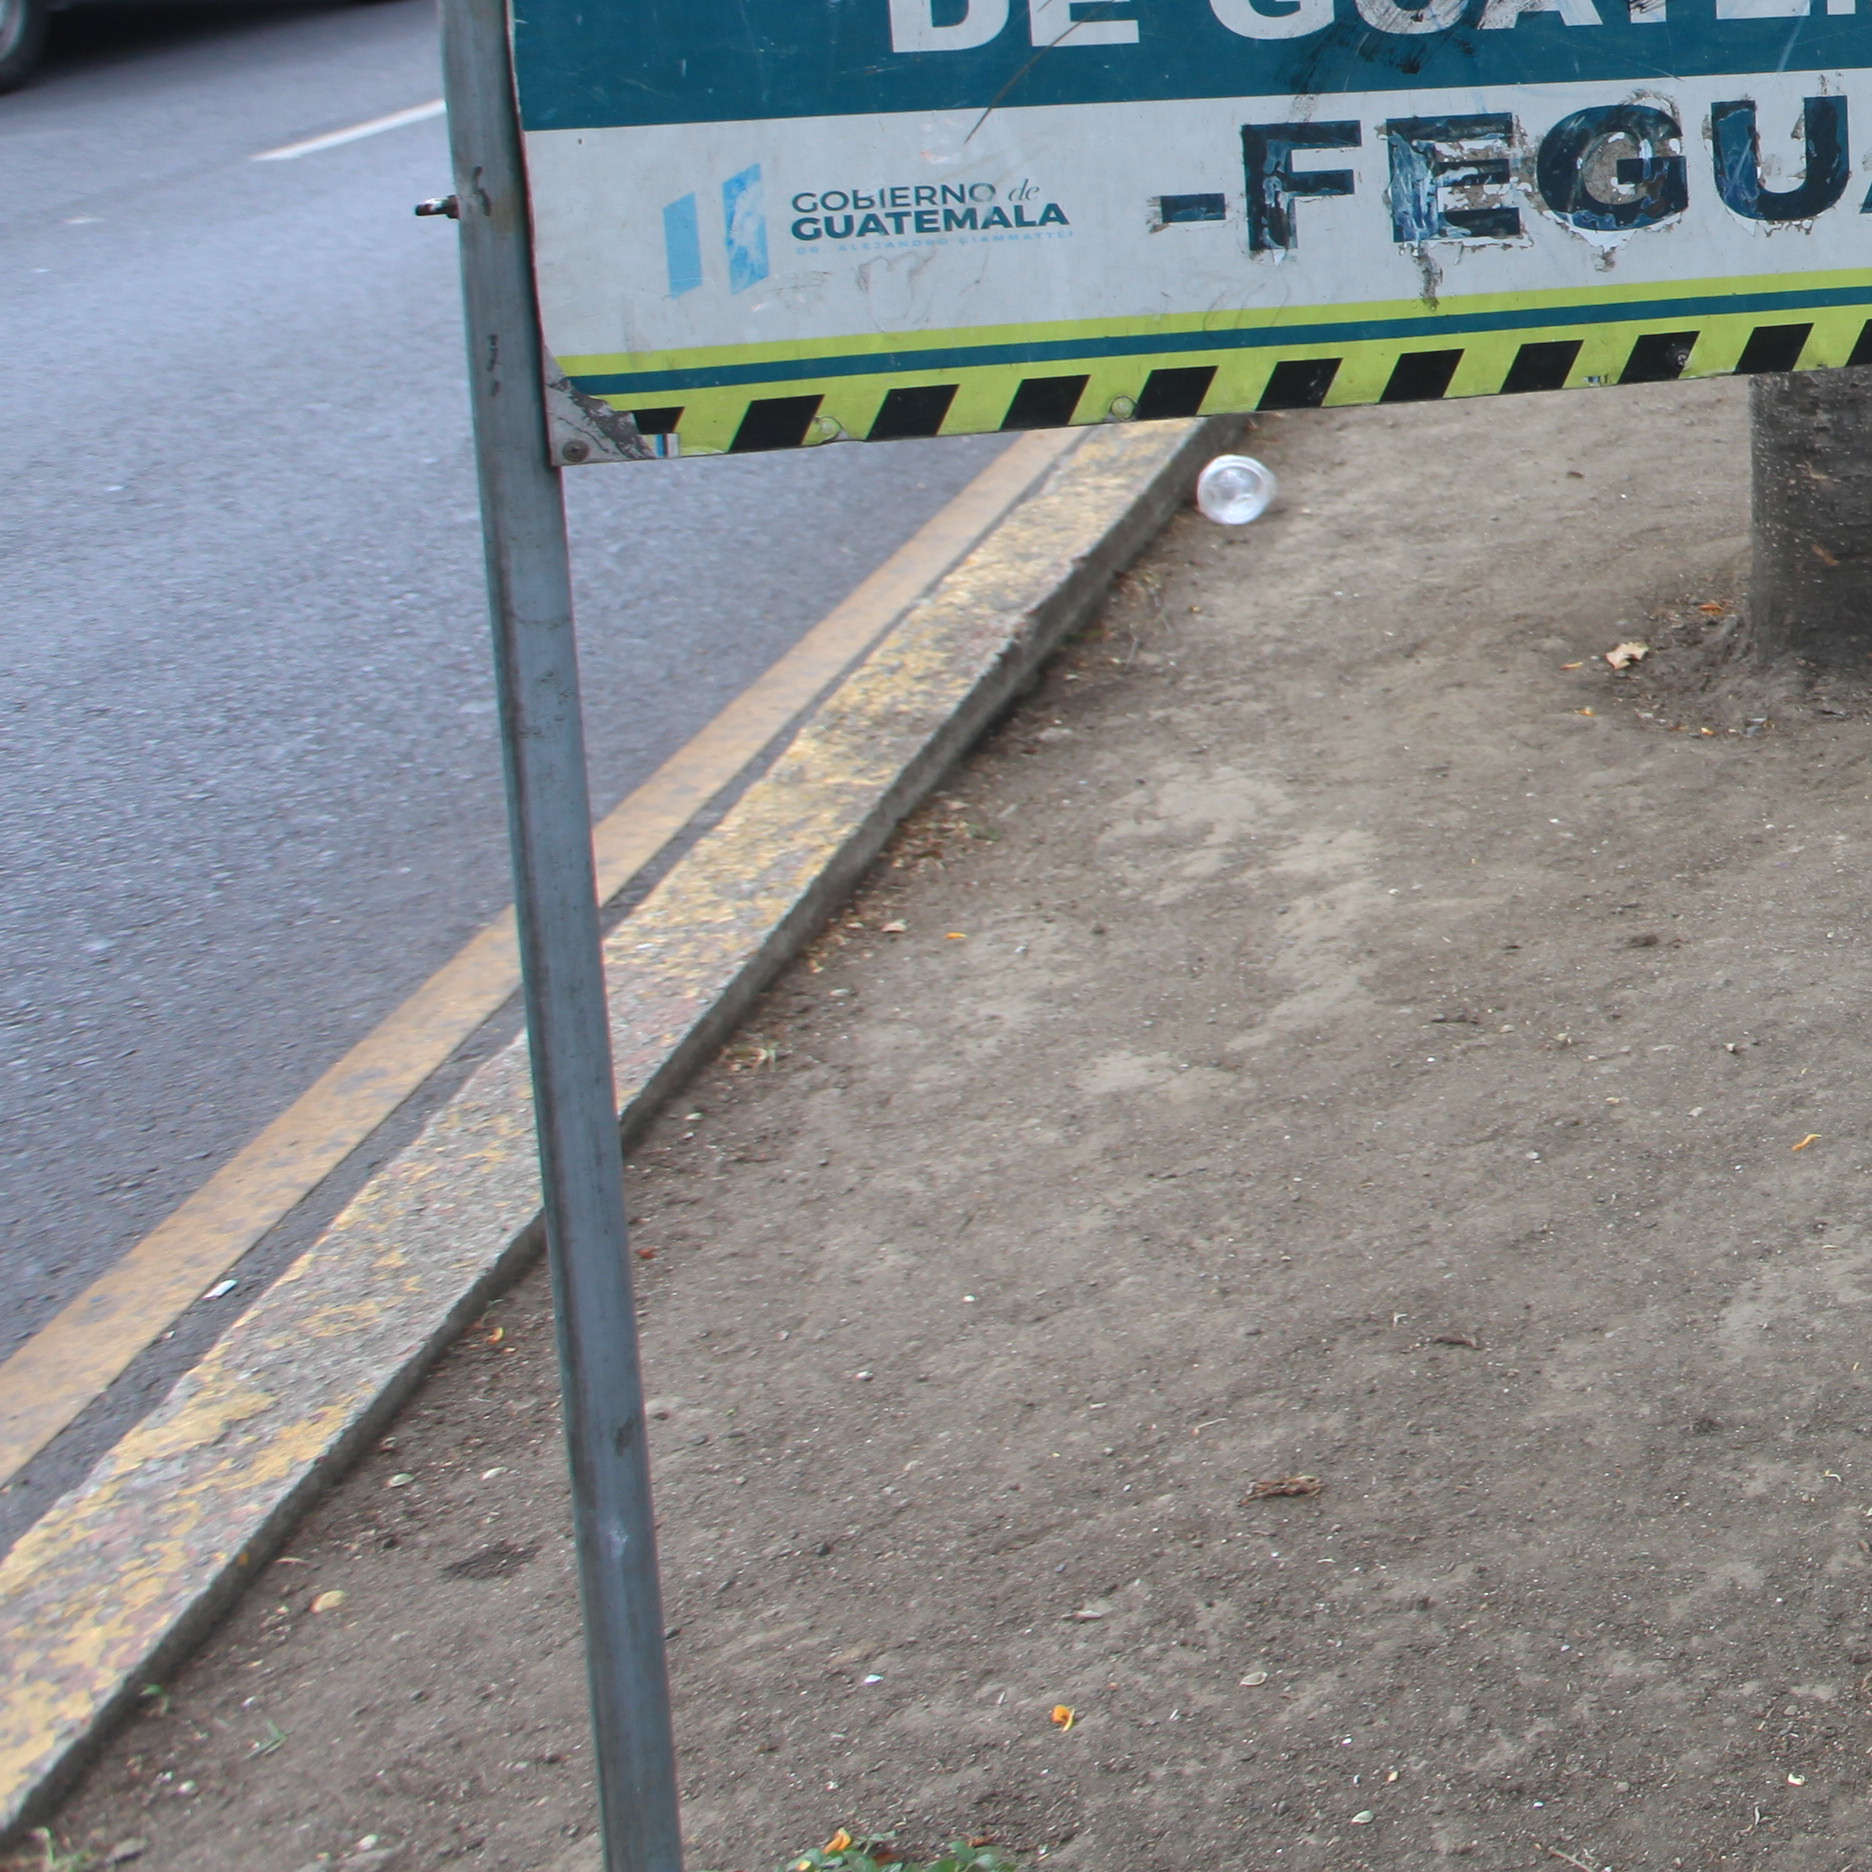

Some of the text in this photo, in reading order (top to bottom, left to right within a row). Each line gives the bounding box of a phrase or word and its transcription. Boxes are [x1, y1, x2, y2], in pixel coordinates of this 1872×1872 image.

[791, 178, 1040, 213] GOBIERNO de
[791, 203, 1071, 241] GUATEMALA
